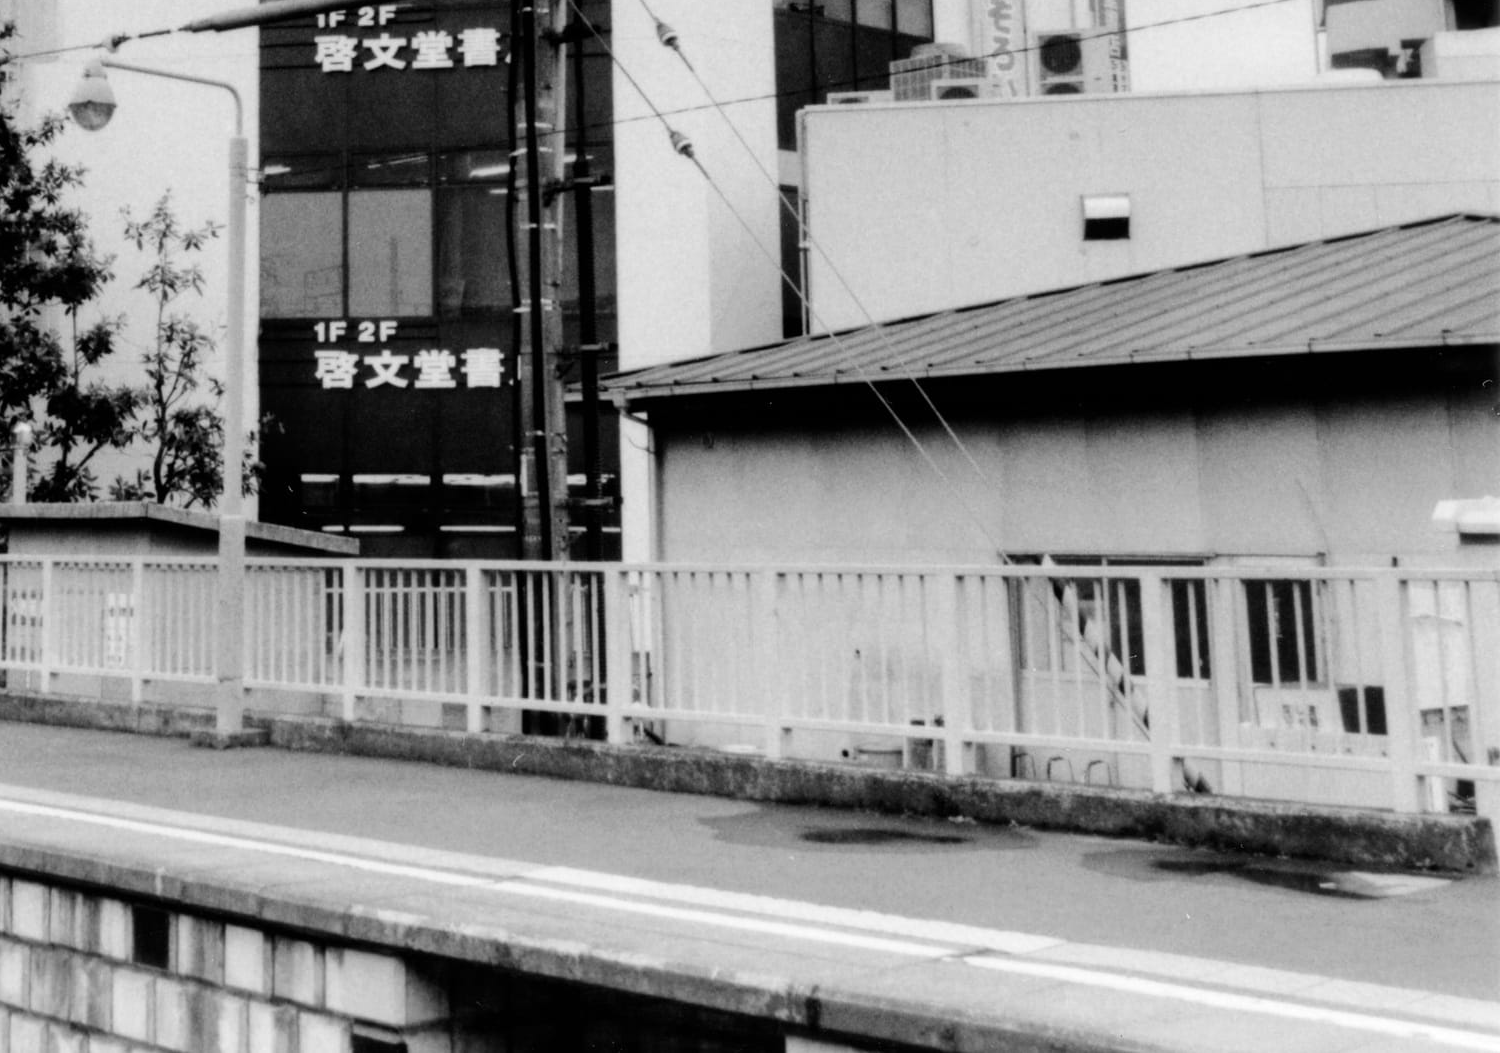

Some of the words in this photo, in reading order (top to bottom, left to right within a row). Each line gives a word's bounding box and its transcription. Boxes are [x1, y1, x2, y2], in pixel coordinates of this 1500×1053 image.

[316, 10, 347, 28] 1F
[357, 5, 397, 27] 2F
[314, 27, 511, 73] 啓文堂書
[313, 321, 348, 343] 1F
[358, 320, 398, 343] 2F
[314, 348, 518, 389] 啓文堂書
